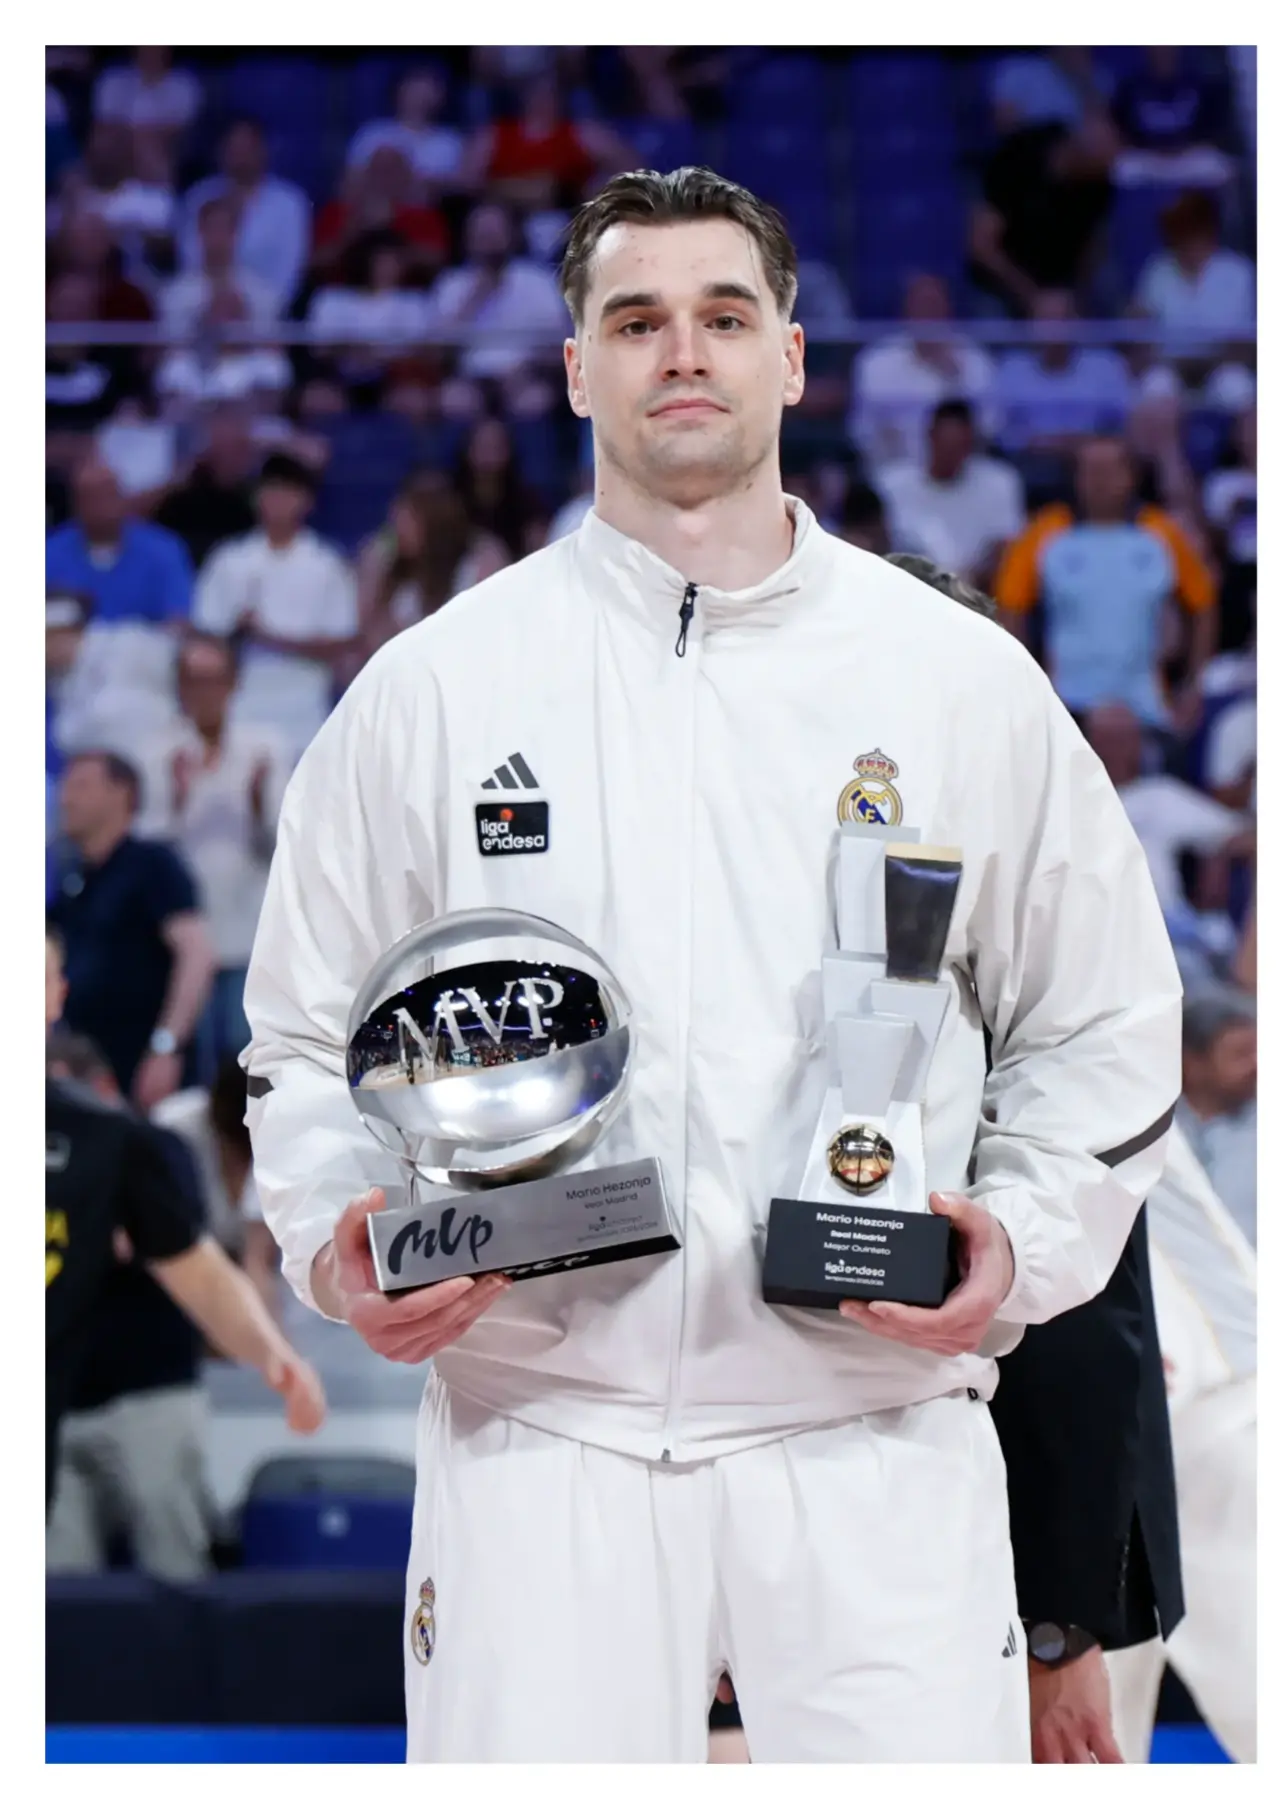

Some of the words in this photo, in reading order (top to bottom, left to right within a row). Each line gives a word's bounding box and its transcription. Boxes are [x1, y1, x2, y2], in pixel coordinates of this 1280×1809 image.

[480, 818, 509, 837] liga
[482, 833, 545, 850] endesa
[392, 976, 564, 1080] MVP
[565, 1186, 601, 1201] Mario
[602, 1176, 652, 1194] Hezonja
[816, 1212, 853, 1224] Mario
[853, 1216, 905, 1230] Hezonja
[852, 1232, 887, 1243] Madrid
